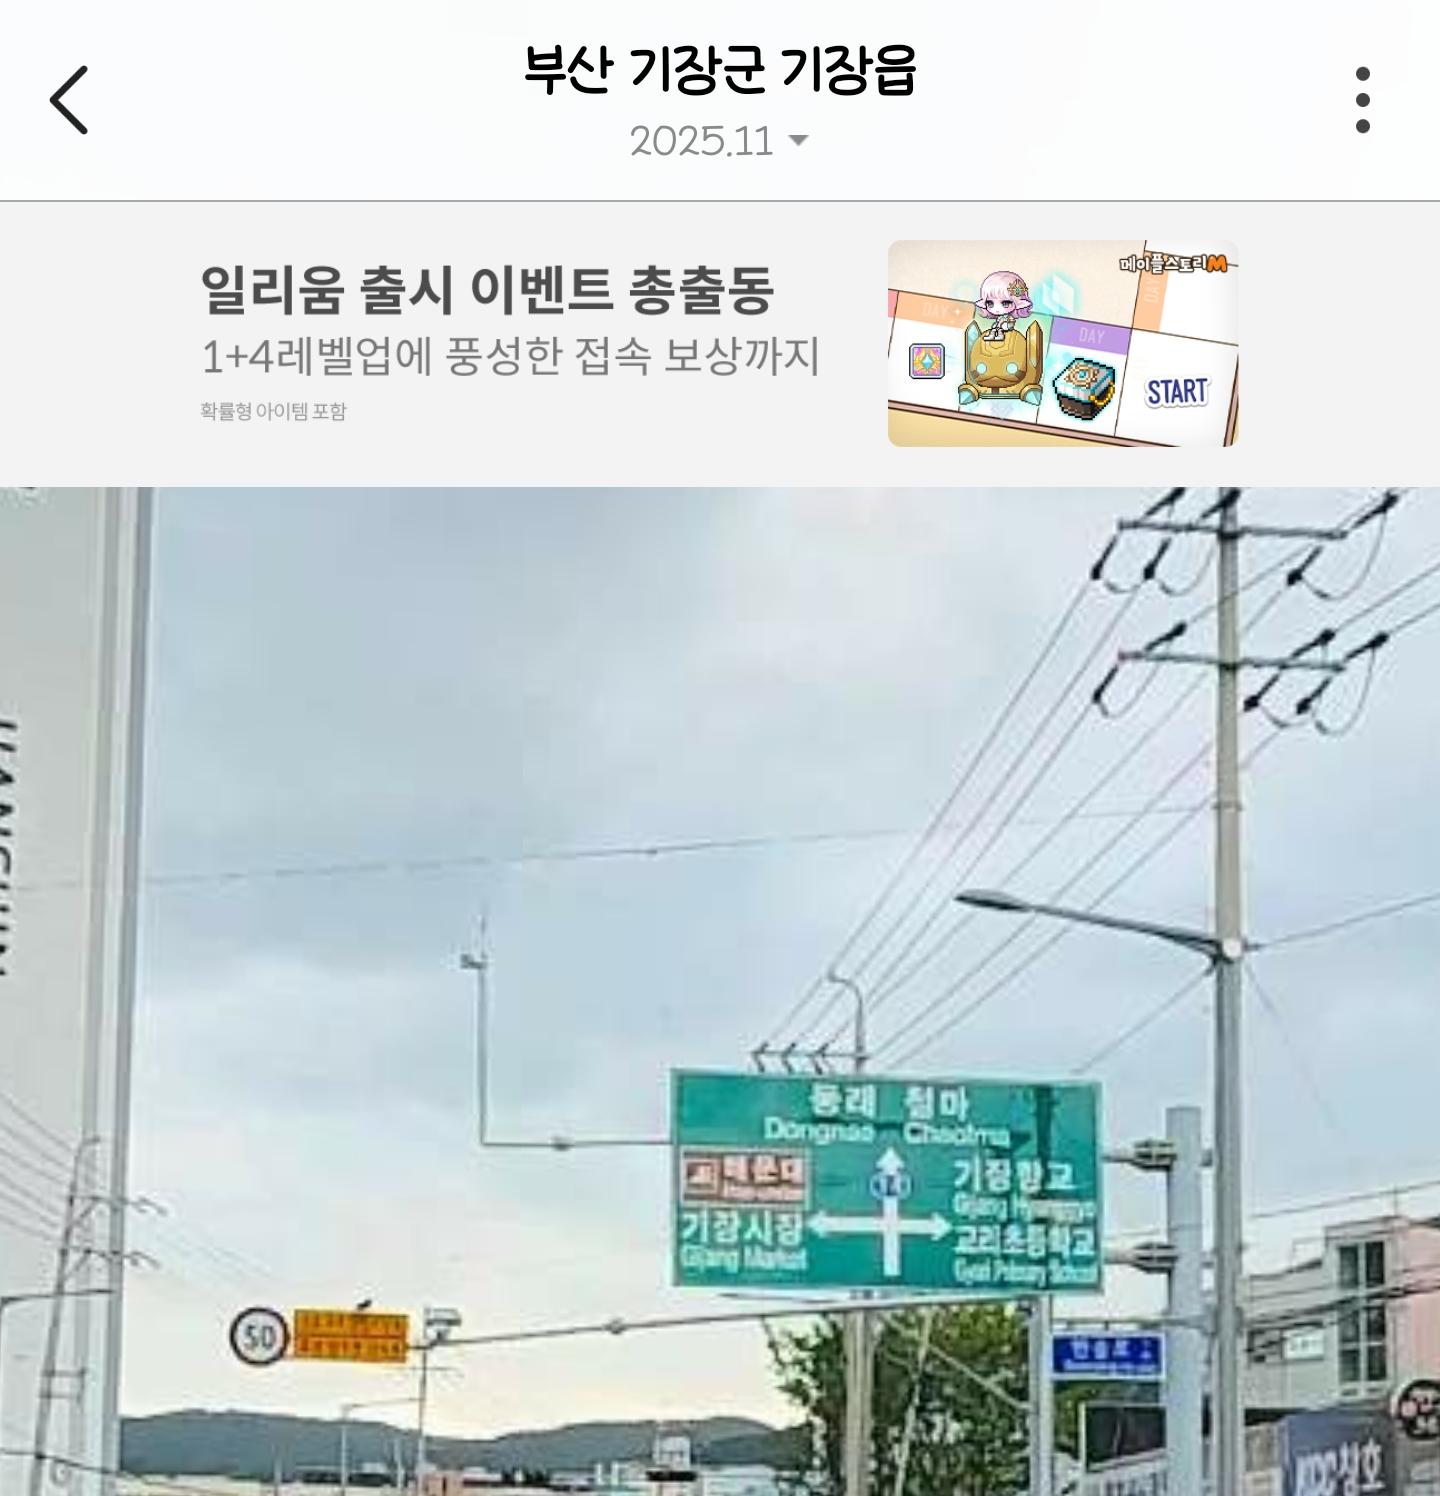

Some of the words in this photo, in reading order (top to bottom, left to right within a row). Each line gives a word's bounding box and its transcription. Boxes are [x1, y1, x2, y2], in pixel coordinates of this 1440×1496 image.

[809, 1083, 877, 1118] 동래
[763, 1116, 875, 1146] Dongnae
[682, 1208, 802, 1246] 기장시장
[244, 1324, 277, 1350] 50
